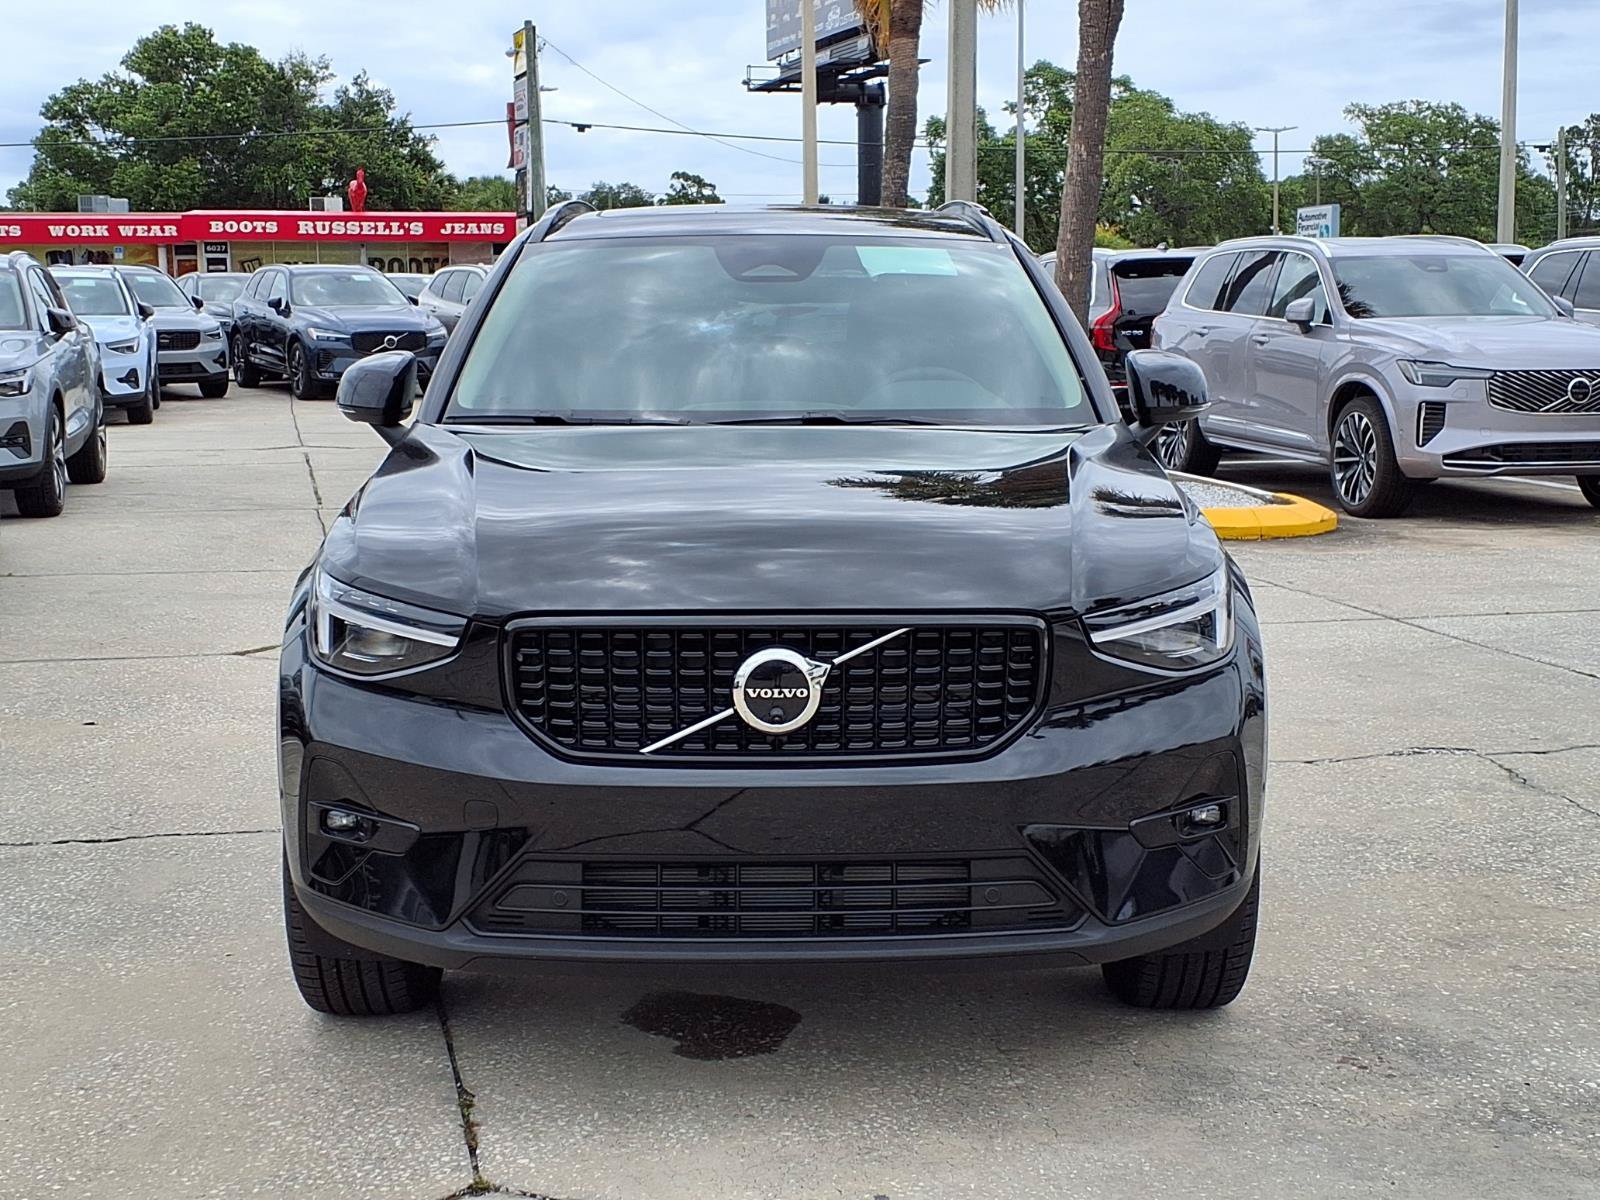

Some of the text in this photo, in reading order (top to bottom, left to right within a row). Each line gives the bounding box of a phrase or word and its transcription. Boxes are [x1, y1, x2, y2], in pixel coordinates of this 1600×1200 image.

[48, 225, 178, 237] WORK WEAR
[209, 221, 278, 233] BOOTS
[297, 221, 424, 235] RUSSELL'S
[440, 222, 505, 235] JEANS
[206, 244, 226, 252] 6027
[746, 688, 808, 698] VOLVO
